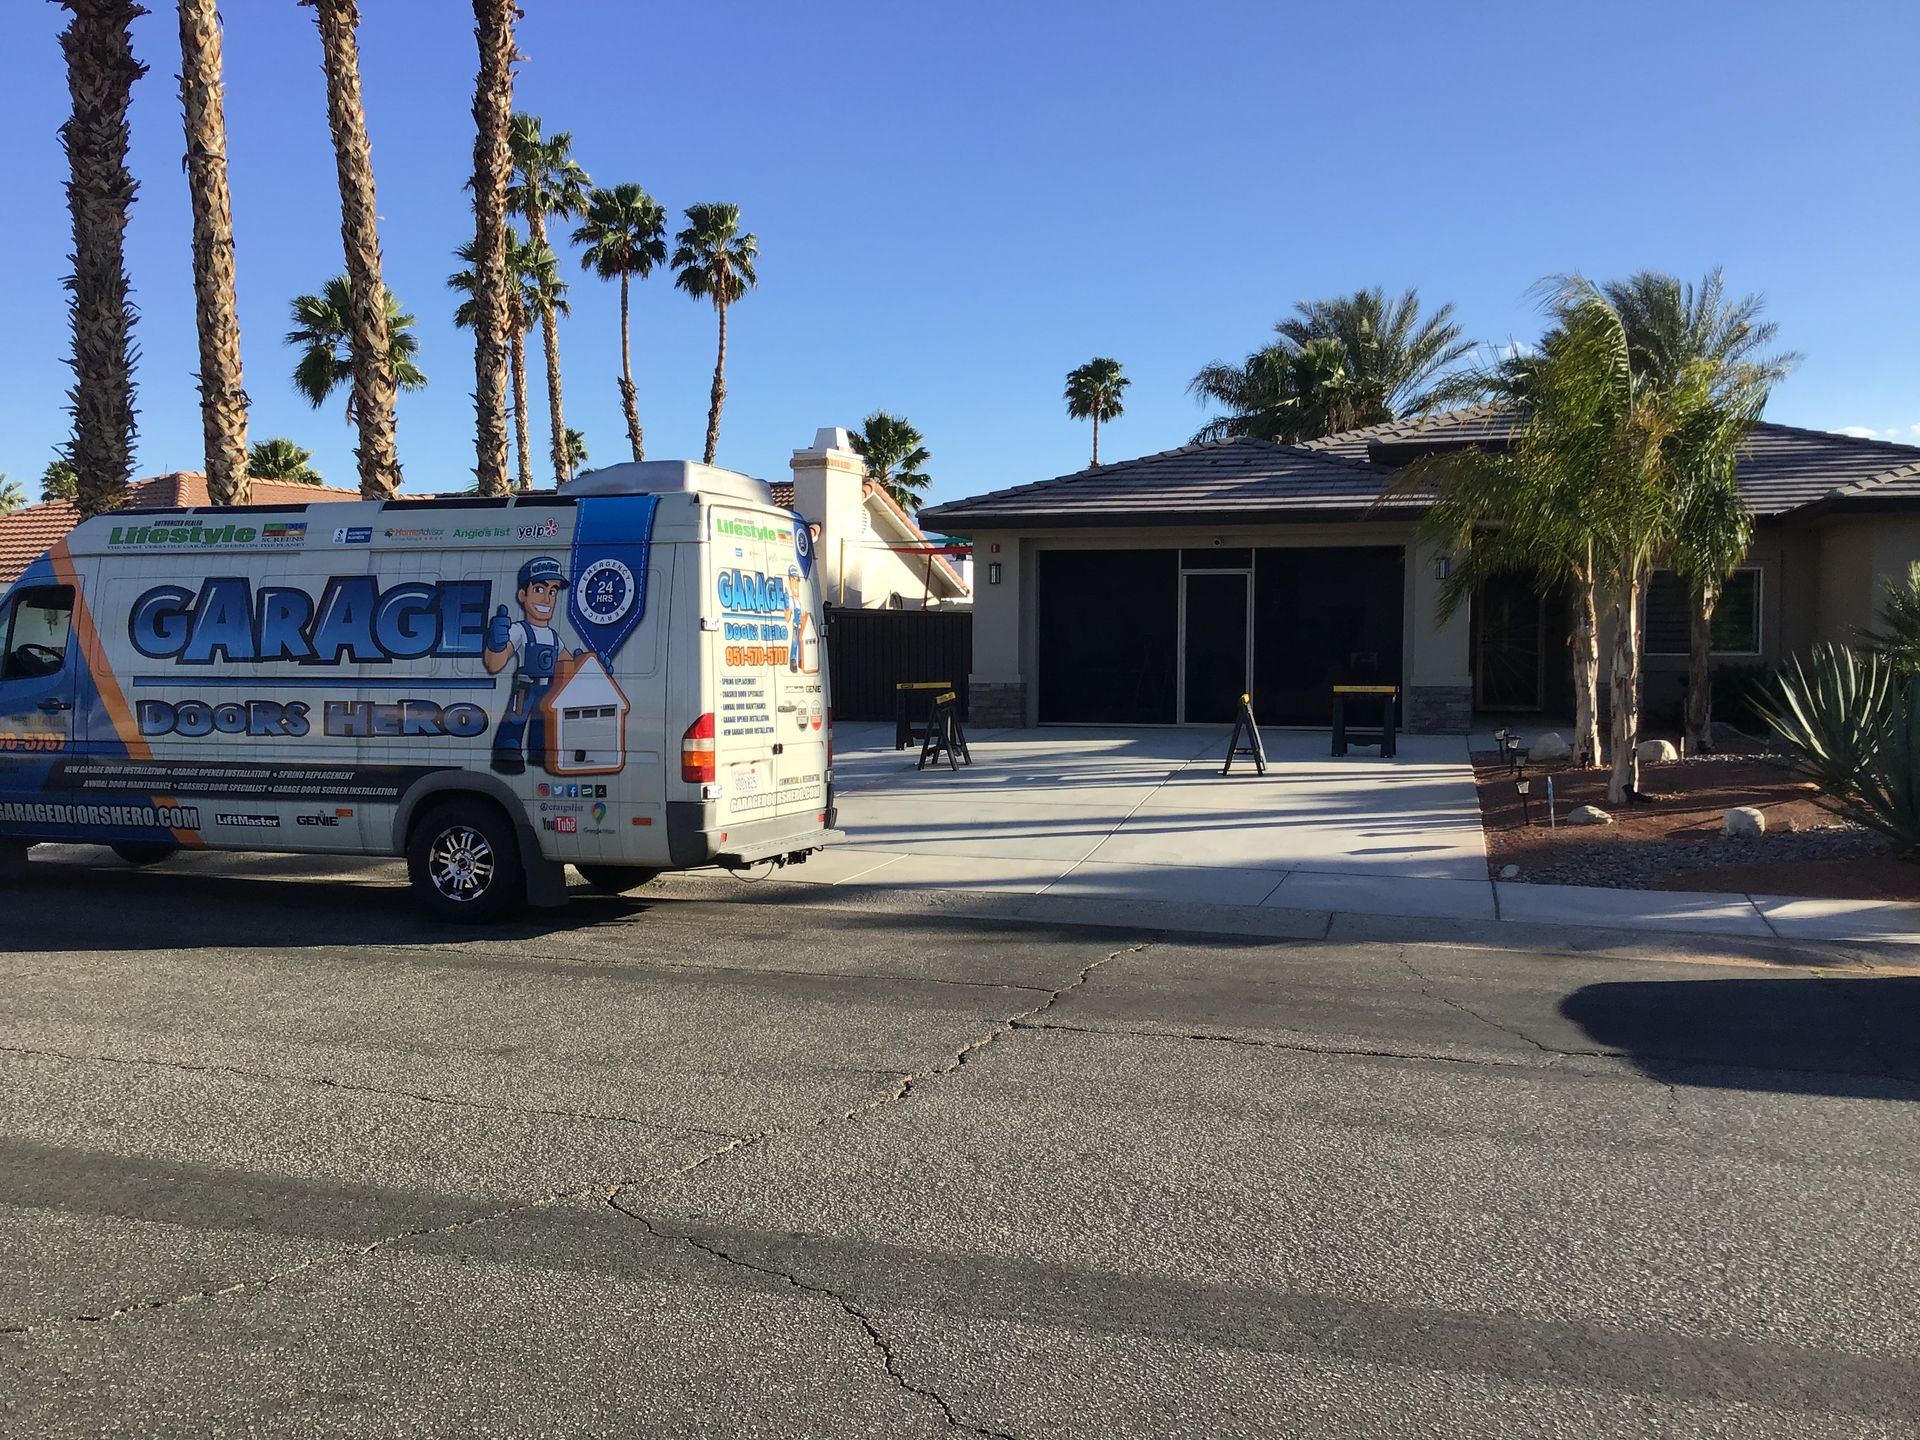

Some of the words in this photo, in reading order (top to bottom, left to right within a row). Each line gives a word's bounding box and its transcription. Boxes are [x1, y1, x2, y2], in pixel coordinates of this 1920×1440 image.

[108, 525, 257, 545] Lifestyle
[494, 527, 511, 537] list
[517, 524, 545, 540] yelp
[716, 518, 777, 541] Lifestyle
[582, 560, 632, 582] EMERGENCY
[597, 581, 614, 594] 24
[718, 568, 786, 613] GARAGE
[596, 594, 614, 603] HRS
[128, 575, 492, 665] GARAGE
[583, 606, 627, 622] SERVICE
[723, 622, 759, 641] DOORS
[760, 624, 789, 641] HERO
[725, 646, 790, 667] 951-570-5707
[136, 700, 310, 737] DOORS
[324, 699, 489, 738] HERO
[172, 768, 199, 776] GARAGE
[199, 768, 225, 777] OPENER
[224, 769, 271, 778] INSTALLATION
[278, 771, 304, 779] SPRING
[304, 771, 355, 780] REPLACEMENT
[209, 783, 229, 791] DOOR
[228, 784, 267, 793] SPECIALIST
[273, 785, 301, 793] GARAGE
[300, 785, 321, 794] DOOR
[321, 786, 349, 795] SCREEN
[348, 787, 398, 796] INSTALLATION
[730, 785, 821, 813] GARAGEDOORSHERO.COM
[216, 814, 279, 827] LiftMaster
[296, 815, 339, 827] GENIE
